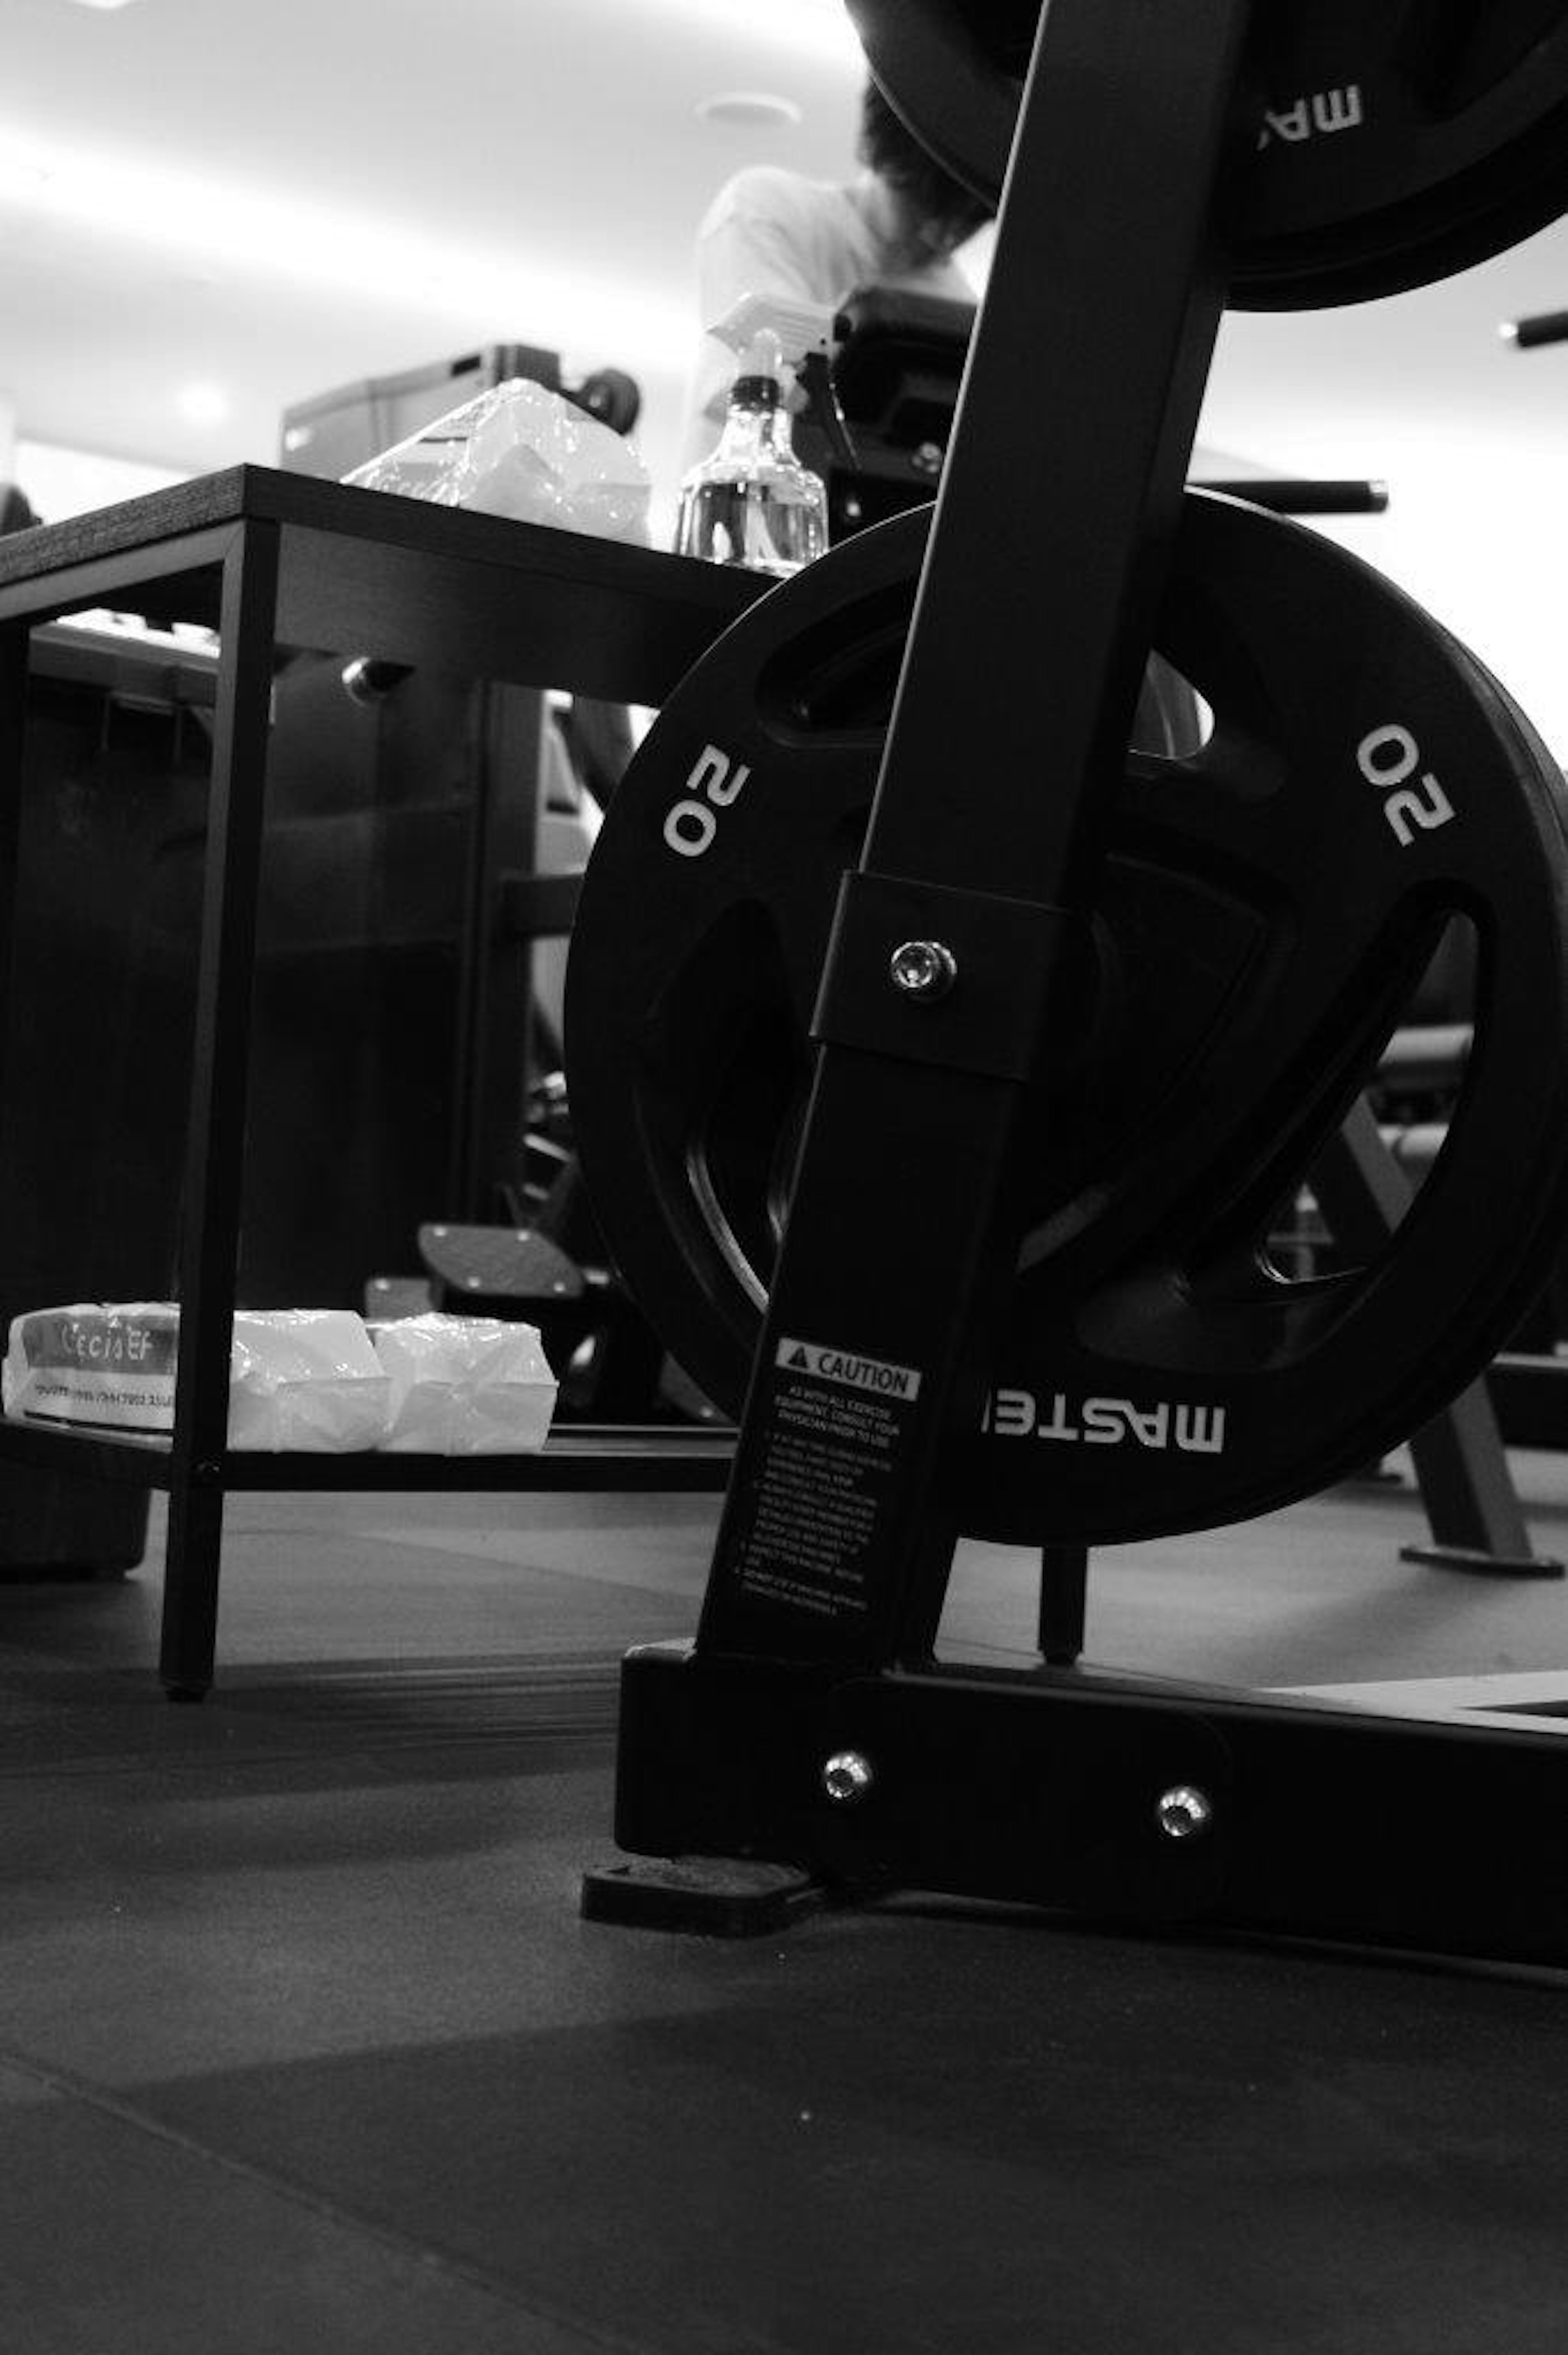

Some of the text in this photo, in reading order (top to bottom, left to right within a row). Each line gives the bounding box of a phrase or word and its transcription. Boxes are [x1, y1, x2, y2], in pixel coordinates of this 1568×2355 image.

[663, 743, 751, 858] 20
[1356, 723, 1457, 847] 20
[819, 1353, 909, 1392] CAUTION
[980, 1387, 1225, 1455] MASTE
